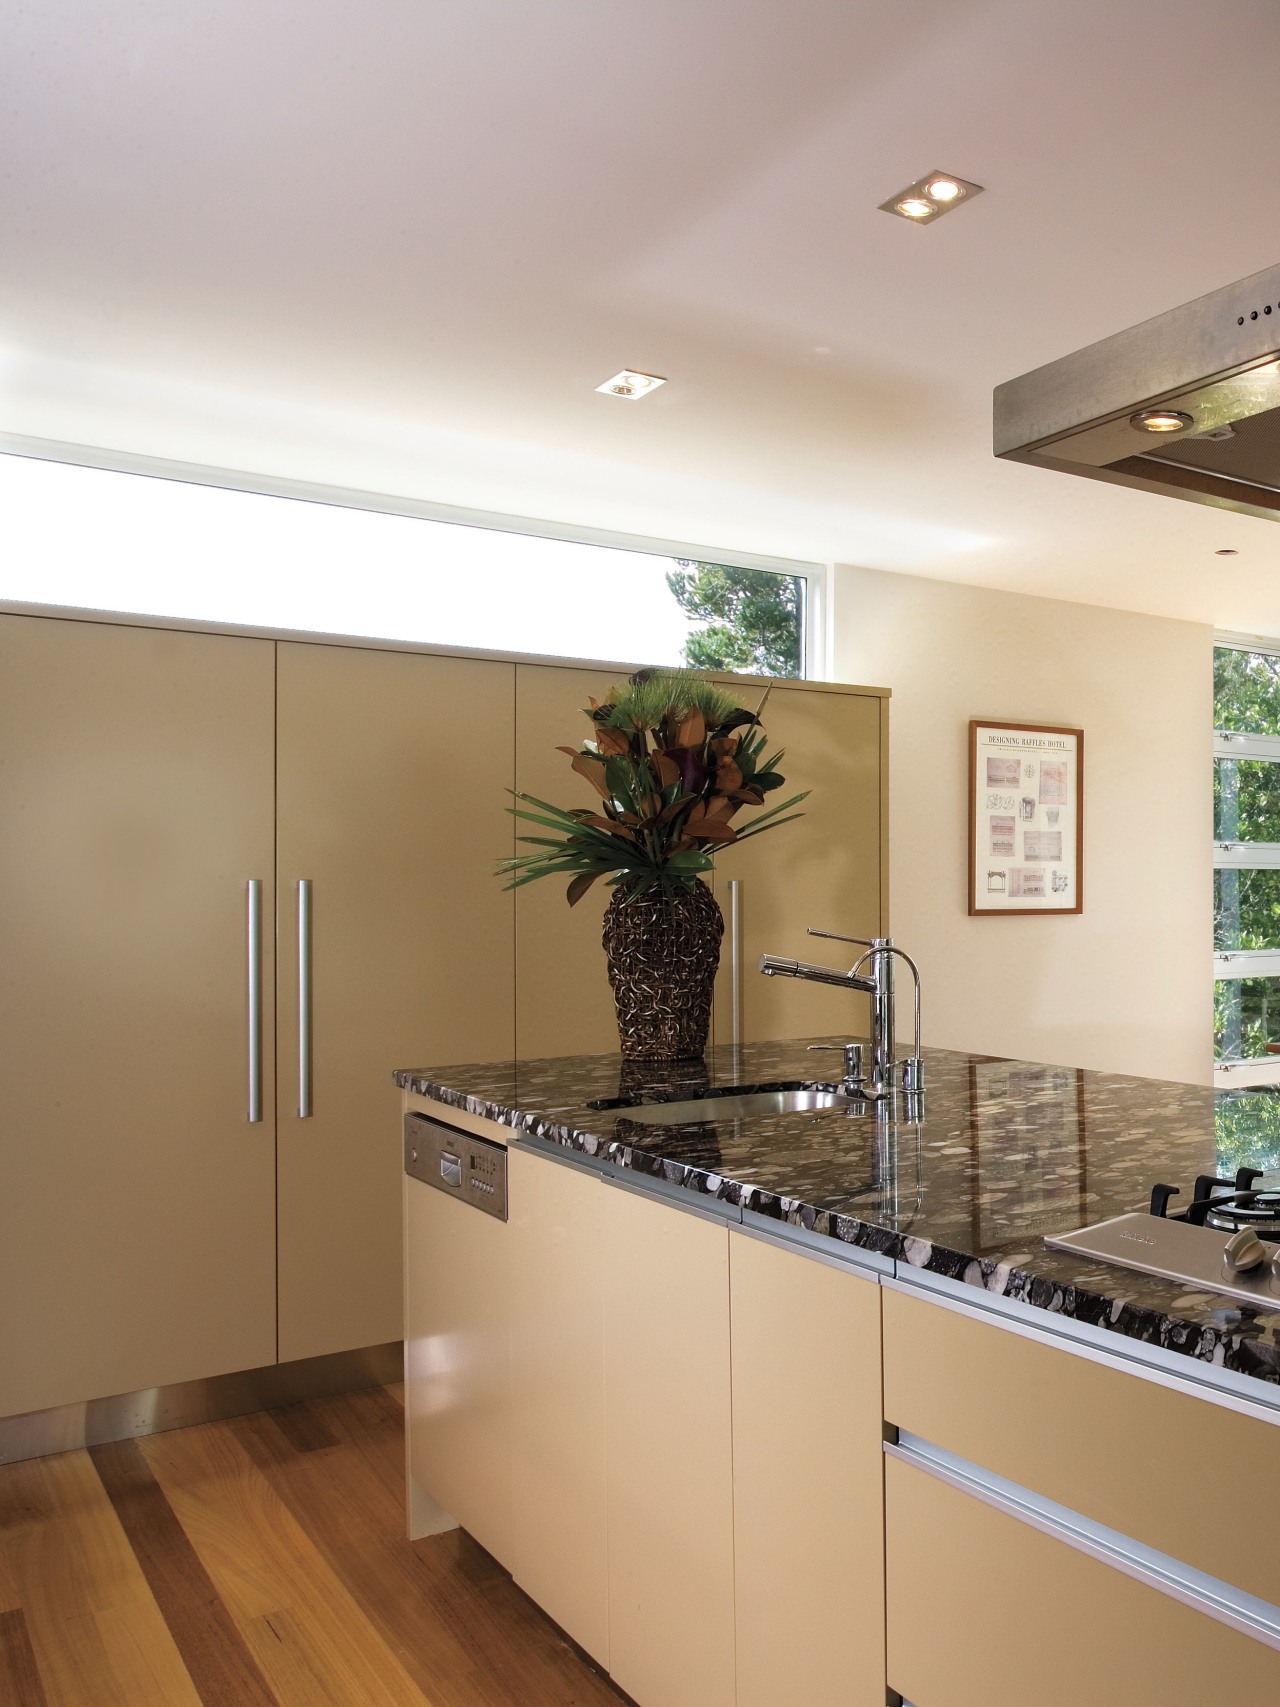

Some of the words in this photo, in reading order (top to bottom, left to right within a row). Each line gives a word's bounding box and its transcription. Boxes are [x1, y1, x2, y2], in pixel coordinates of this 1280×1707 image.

[988, 735, 1020, 745] DESIGNING
[1021, 738, 1046, 747] RAFFLES
[1047, 740, 1066, 748] HOTEL
